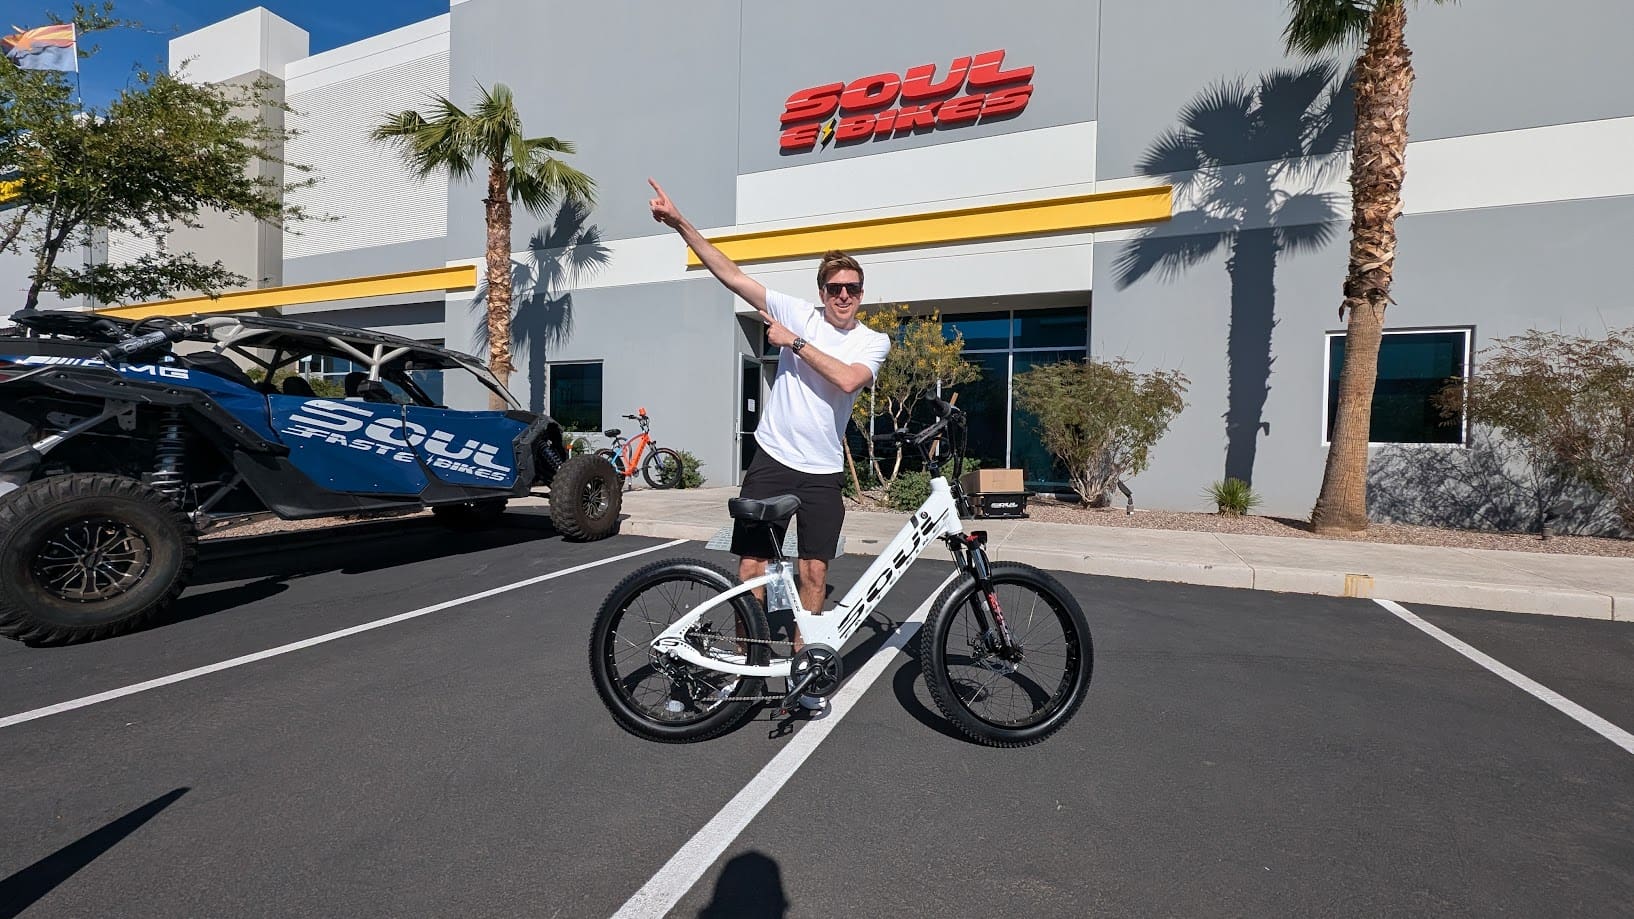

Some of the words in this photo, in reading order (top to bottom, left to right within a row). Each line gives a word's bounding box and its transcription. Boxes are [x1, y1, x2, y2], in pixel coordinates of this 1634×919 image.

[779, 49, 1034, 128] SOUL
[289, 399, 512, 472] SOUL
[837, 507, 949, 639] SOUL
